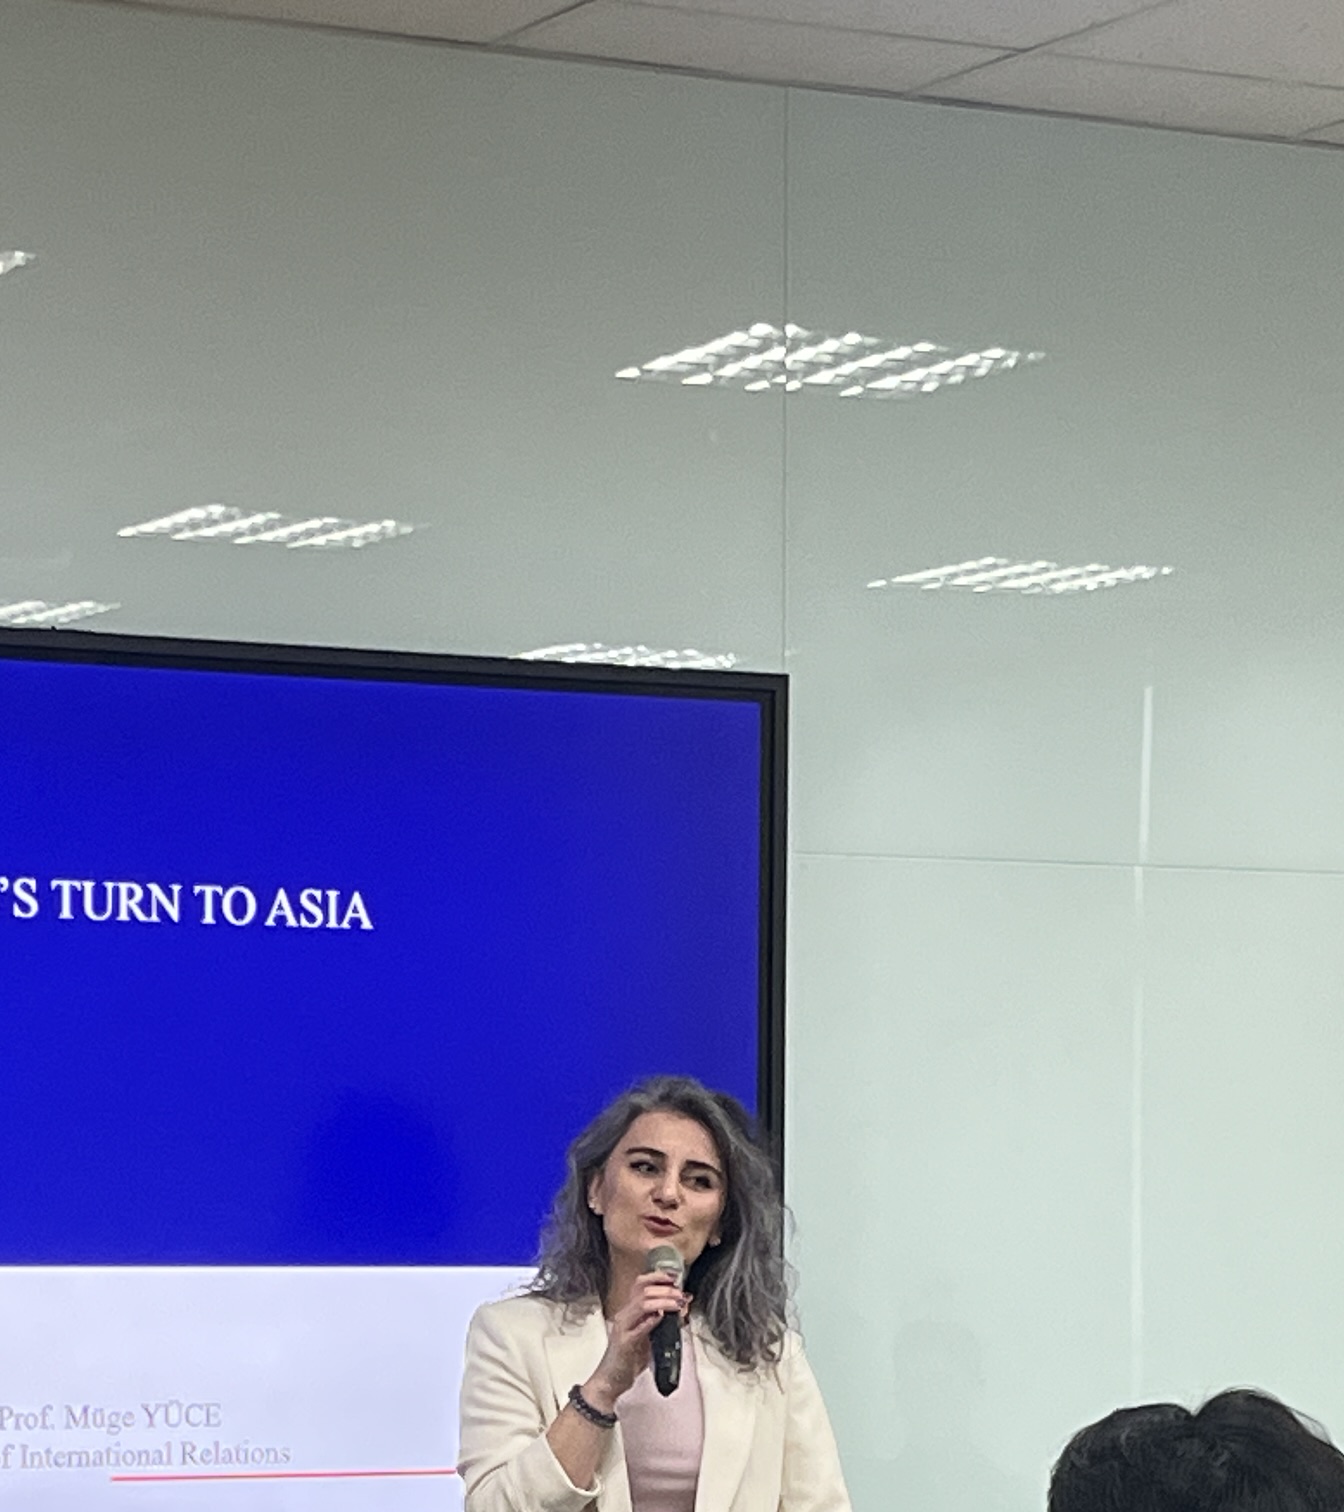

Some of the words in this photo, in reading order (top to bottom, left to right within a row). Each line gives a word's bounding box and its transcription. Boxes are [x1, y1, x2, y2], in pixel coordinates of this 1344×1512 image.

[51, 878, 183, 923] TURN
[193, 884, 256, 926] TO
[264, 887, 374, 930] ASIA
[64, 1404, 135, 1435] Müge
[141, 1399, 223, 1428] YÜCE
[19, 1440, 173, 1469] International
[180, 1439, 291, 1466] Relations
